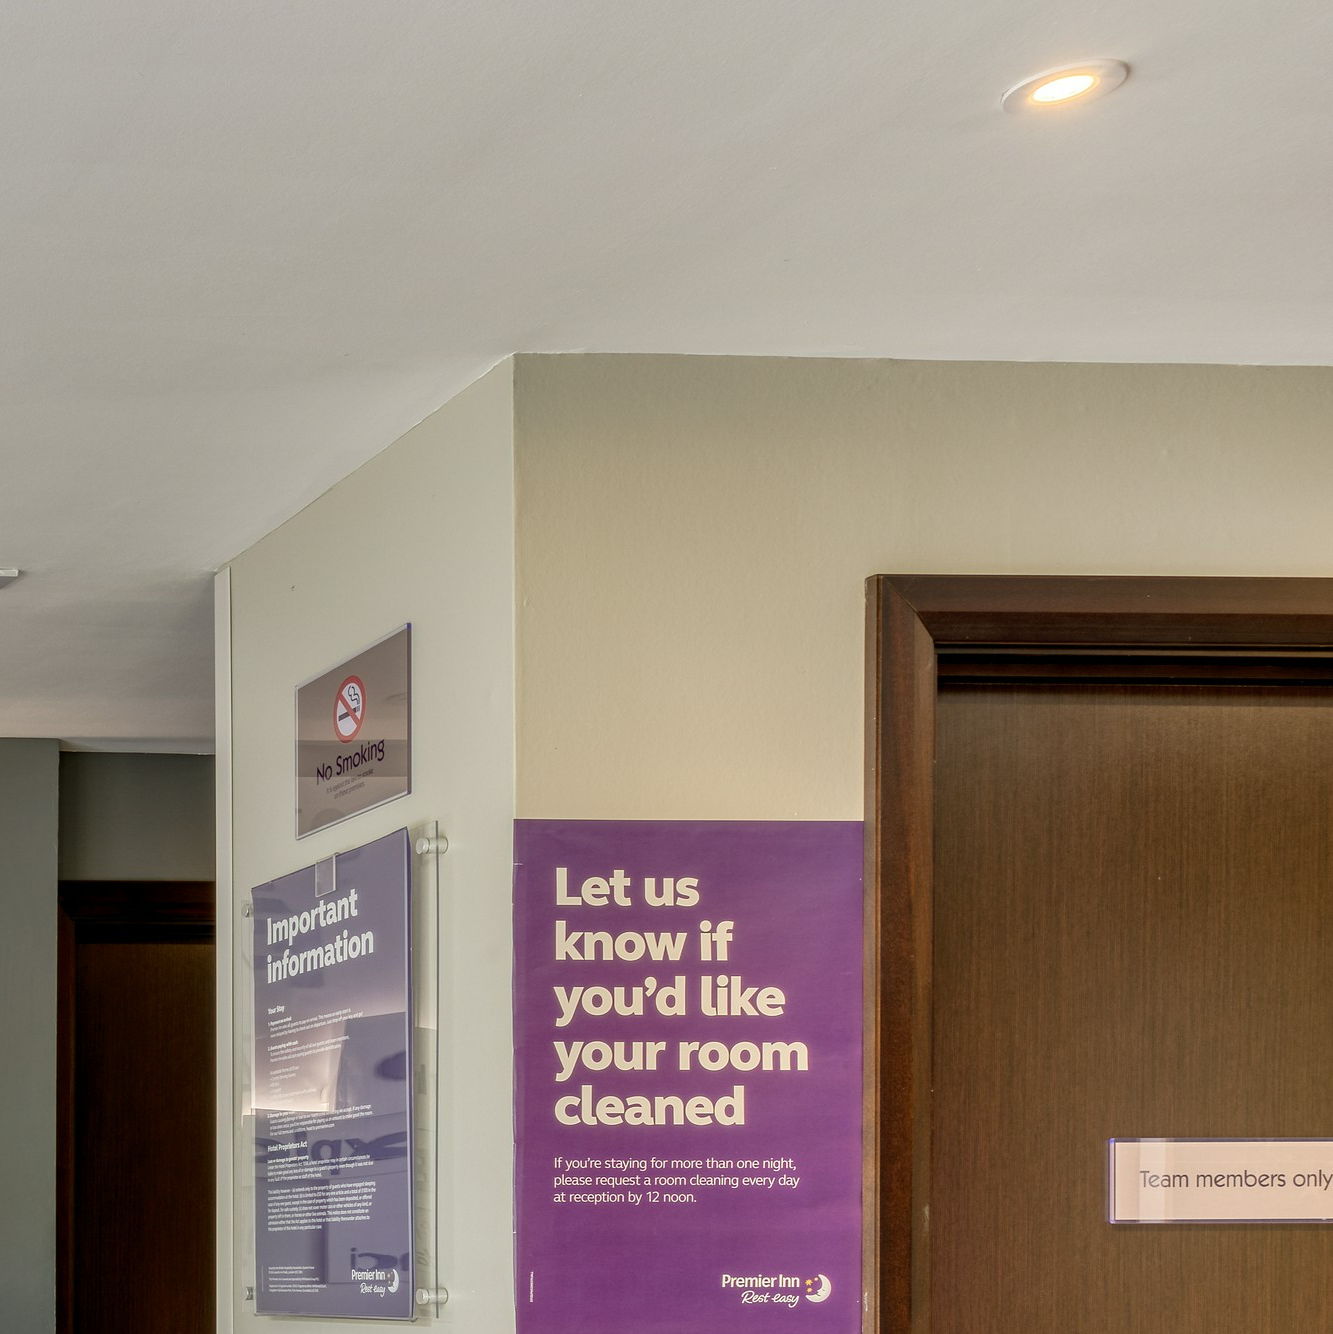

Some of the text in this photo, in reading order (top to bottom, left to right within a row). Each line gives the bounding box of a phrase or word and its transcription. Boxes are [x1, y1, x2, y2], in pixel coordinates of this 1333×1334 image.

[317, 764, 332, 785] No
[336, 740, 384, 776] Smoking
[556, 868, 699, 906] Let us
[267, 888, 357, 945] Important
[267, 929, 374, 984] information
[556, 920, 734, 961] know if
[553, 975, 785, 1027] you’d like
[553, 1041, 808, 1081] your room
[555, 1085, 745, 1125] cleaned
[554, 1174, 800, 1188] please request a room cleaning every day
[555, 1157, 796, 1171] If you’re staying for more than one night,
[1140, 1169, 1333, 1191] Team members only
[554, 1191, 696, 1205] at reception by 12 noon.
[352, 1269, 385, 1280] Premier Inn
[722, 1274, 800, 1287] Premier Inn
[741, 1290, 799, 1308] Rest easy
